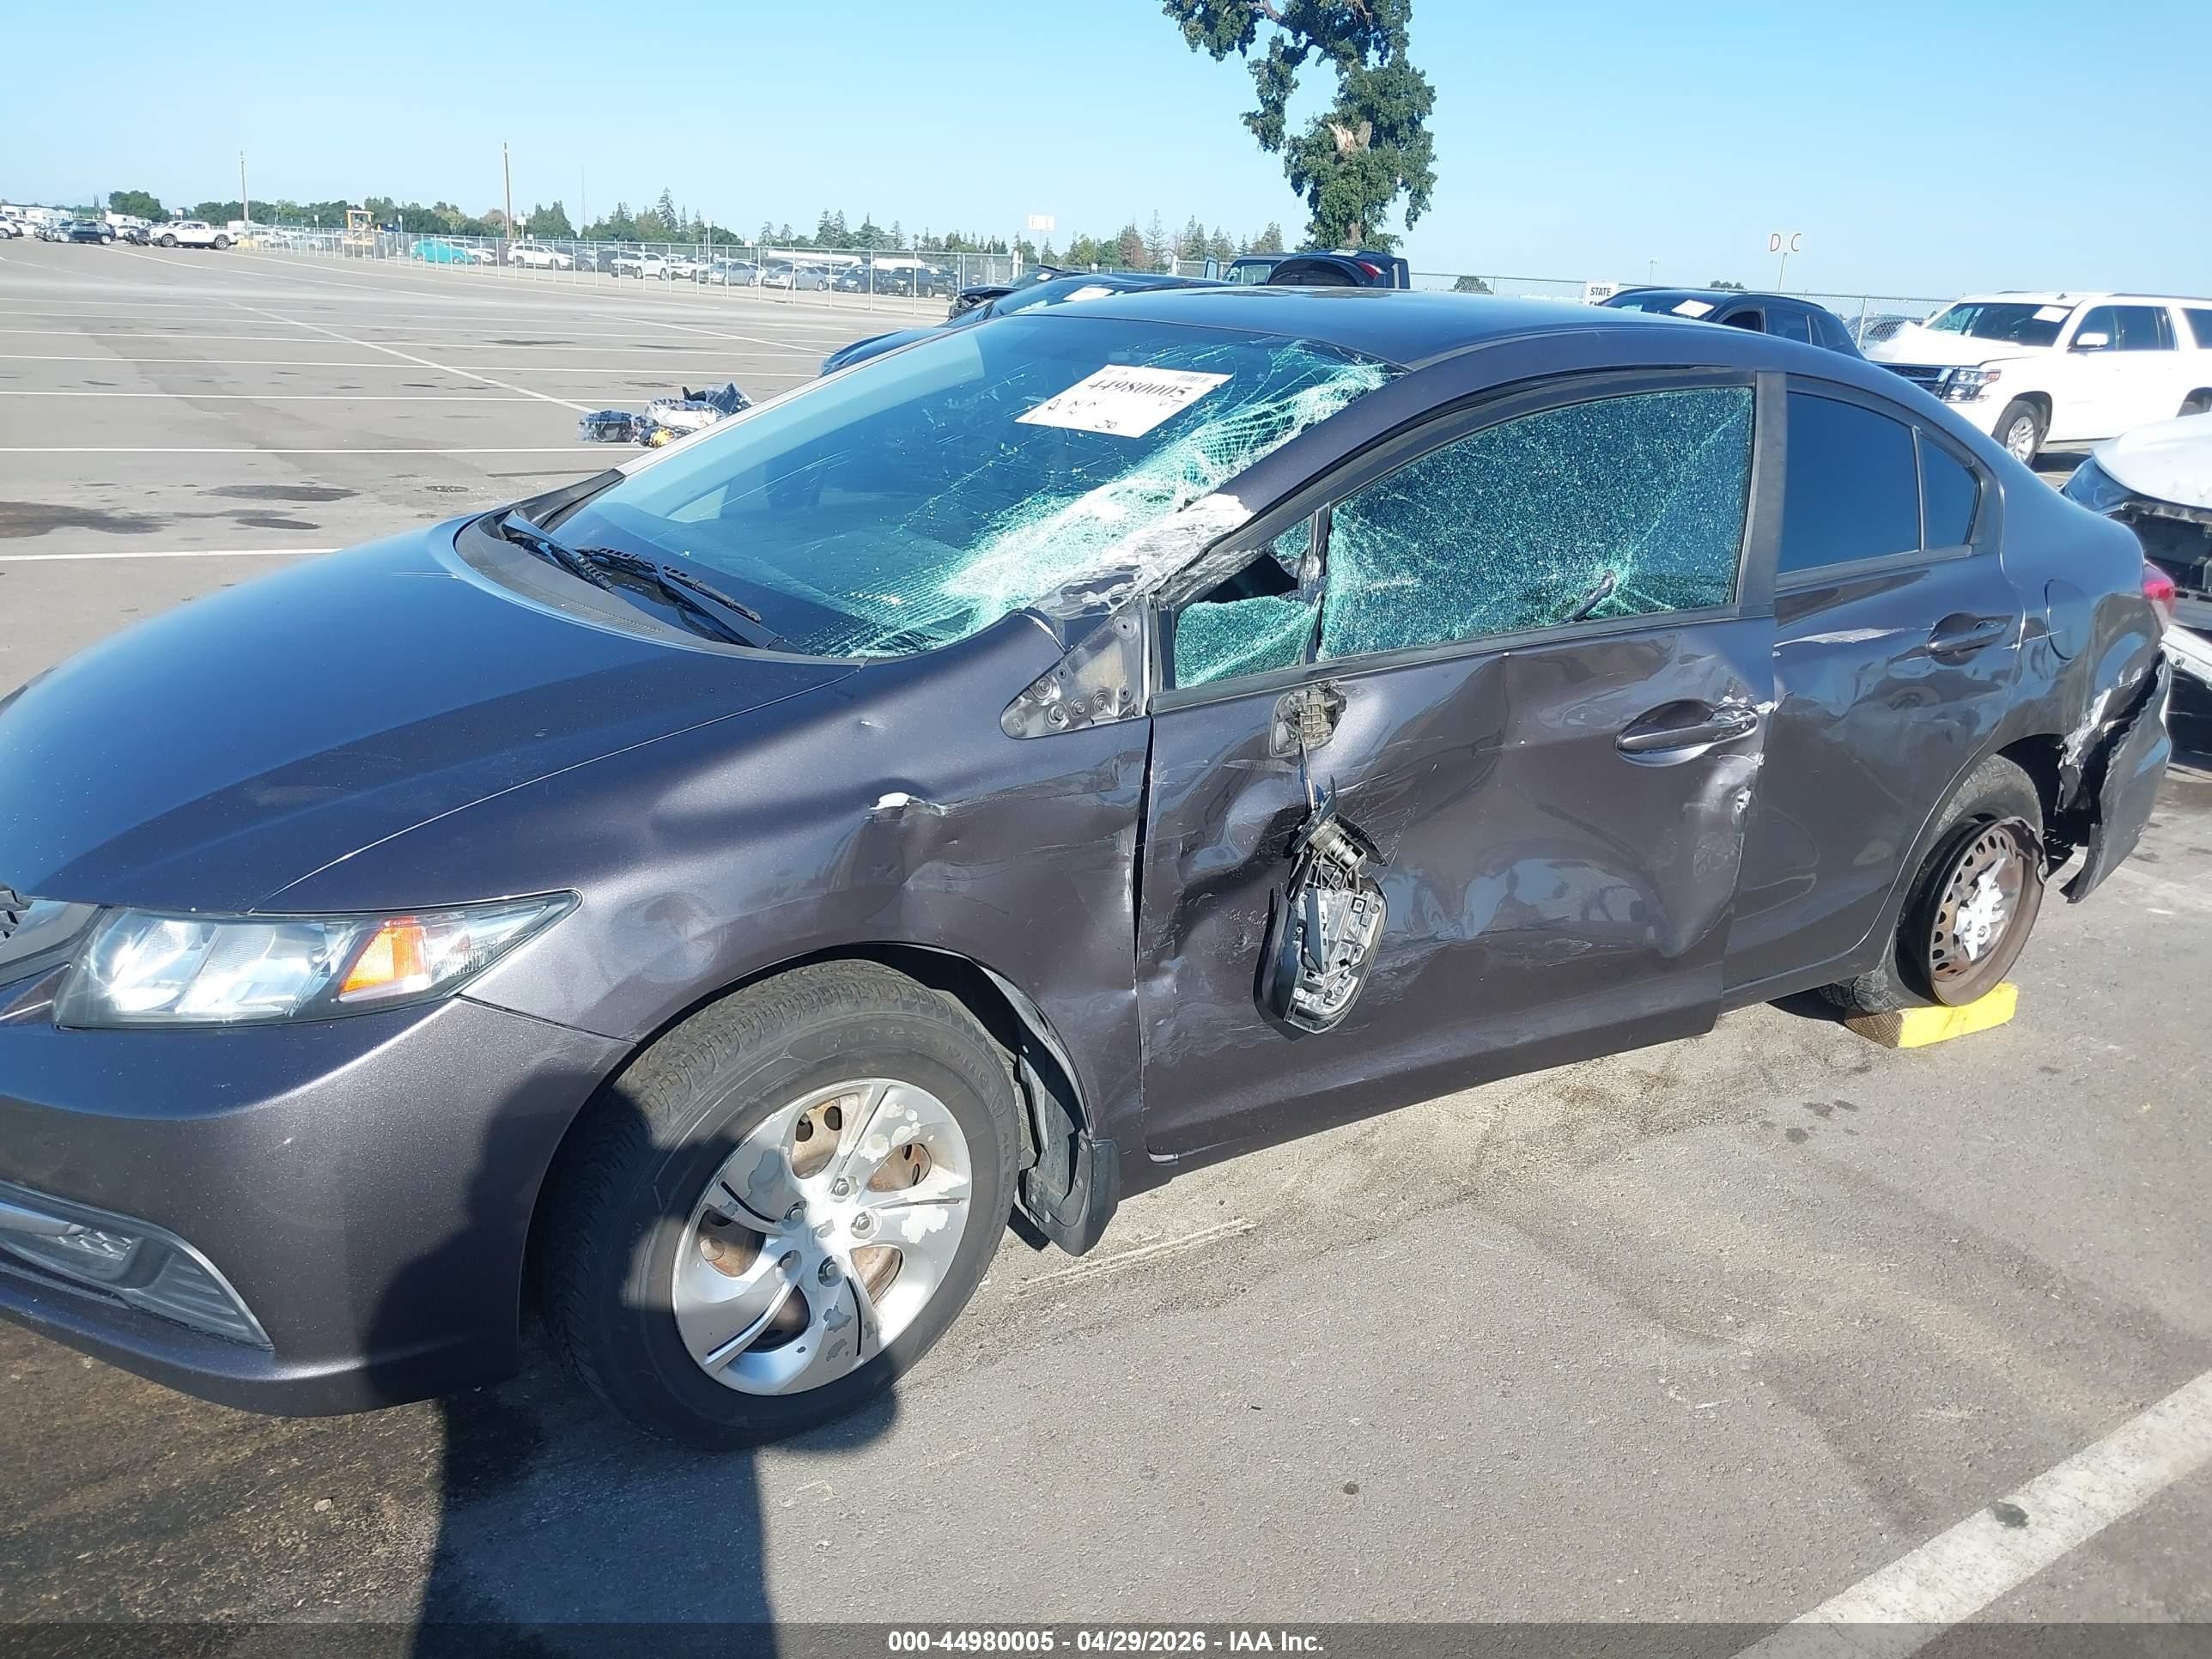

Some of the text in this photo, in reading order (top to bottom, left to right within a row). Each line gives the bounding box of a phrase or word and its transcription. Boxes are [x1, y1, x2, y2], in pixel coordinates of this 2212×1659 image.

[1770, 233, 1802, 252] D C
[1589, 287, 1612, 296] STATE
[1087, 379, 1194, 398] 44980005
